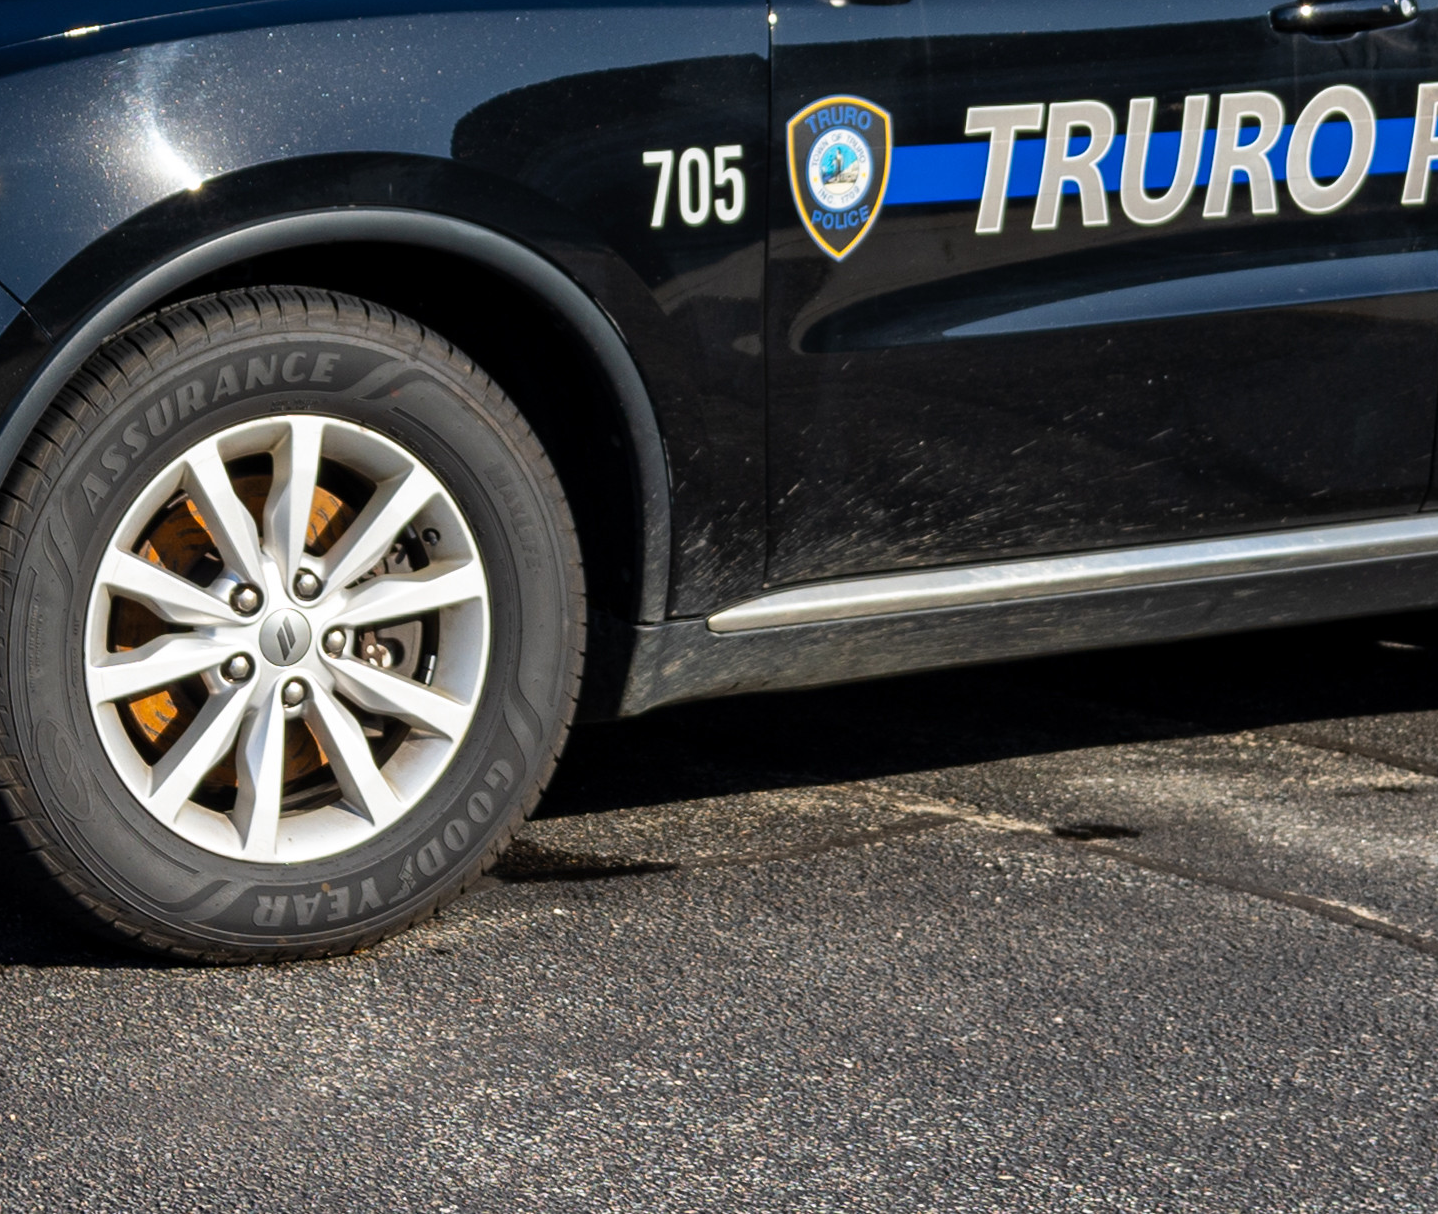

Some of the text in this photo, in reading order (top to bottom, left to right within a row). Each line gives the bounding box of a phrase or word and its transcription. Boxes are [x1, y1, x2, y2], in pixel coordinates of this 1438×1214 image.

[804, 105, 872, 134] TRURO
[811, 132, 866, 166] TOWN OF TRURO
[642, 144, 746, 229] 705
[964, 83, 1377, 234] TRURO
[811, 204, 870, 231] POLICE
[80, 350, 341, 516] ASSURANCE
